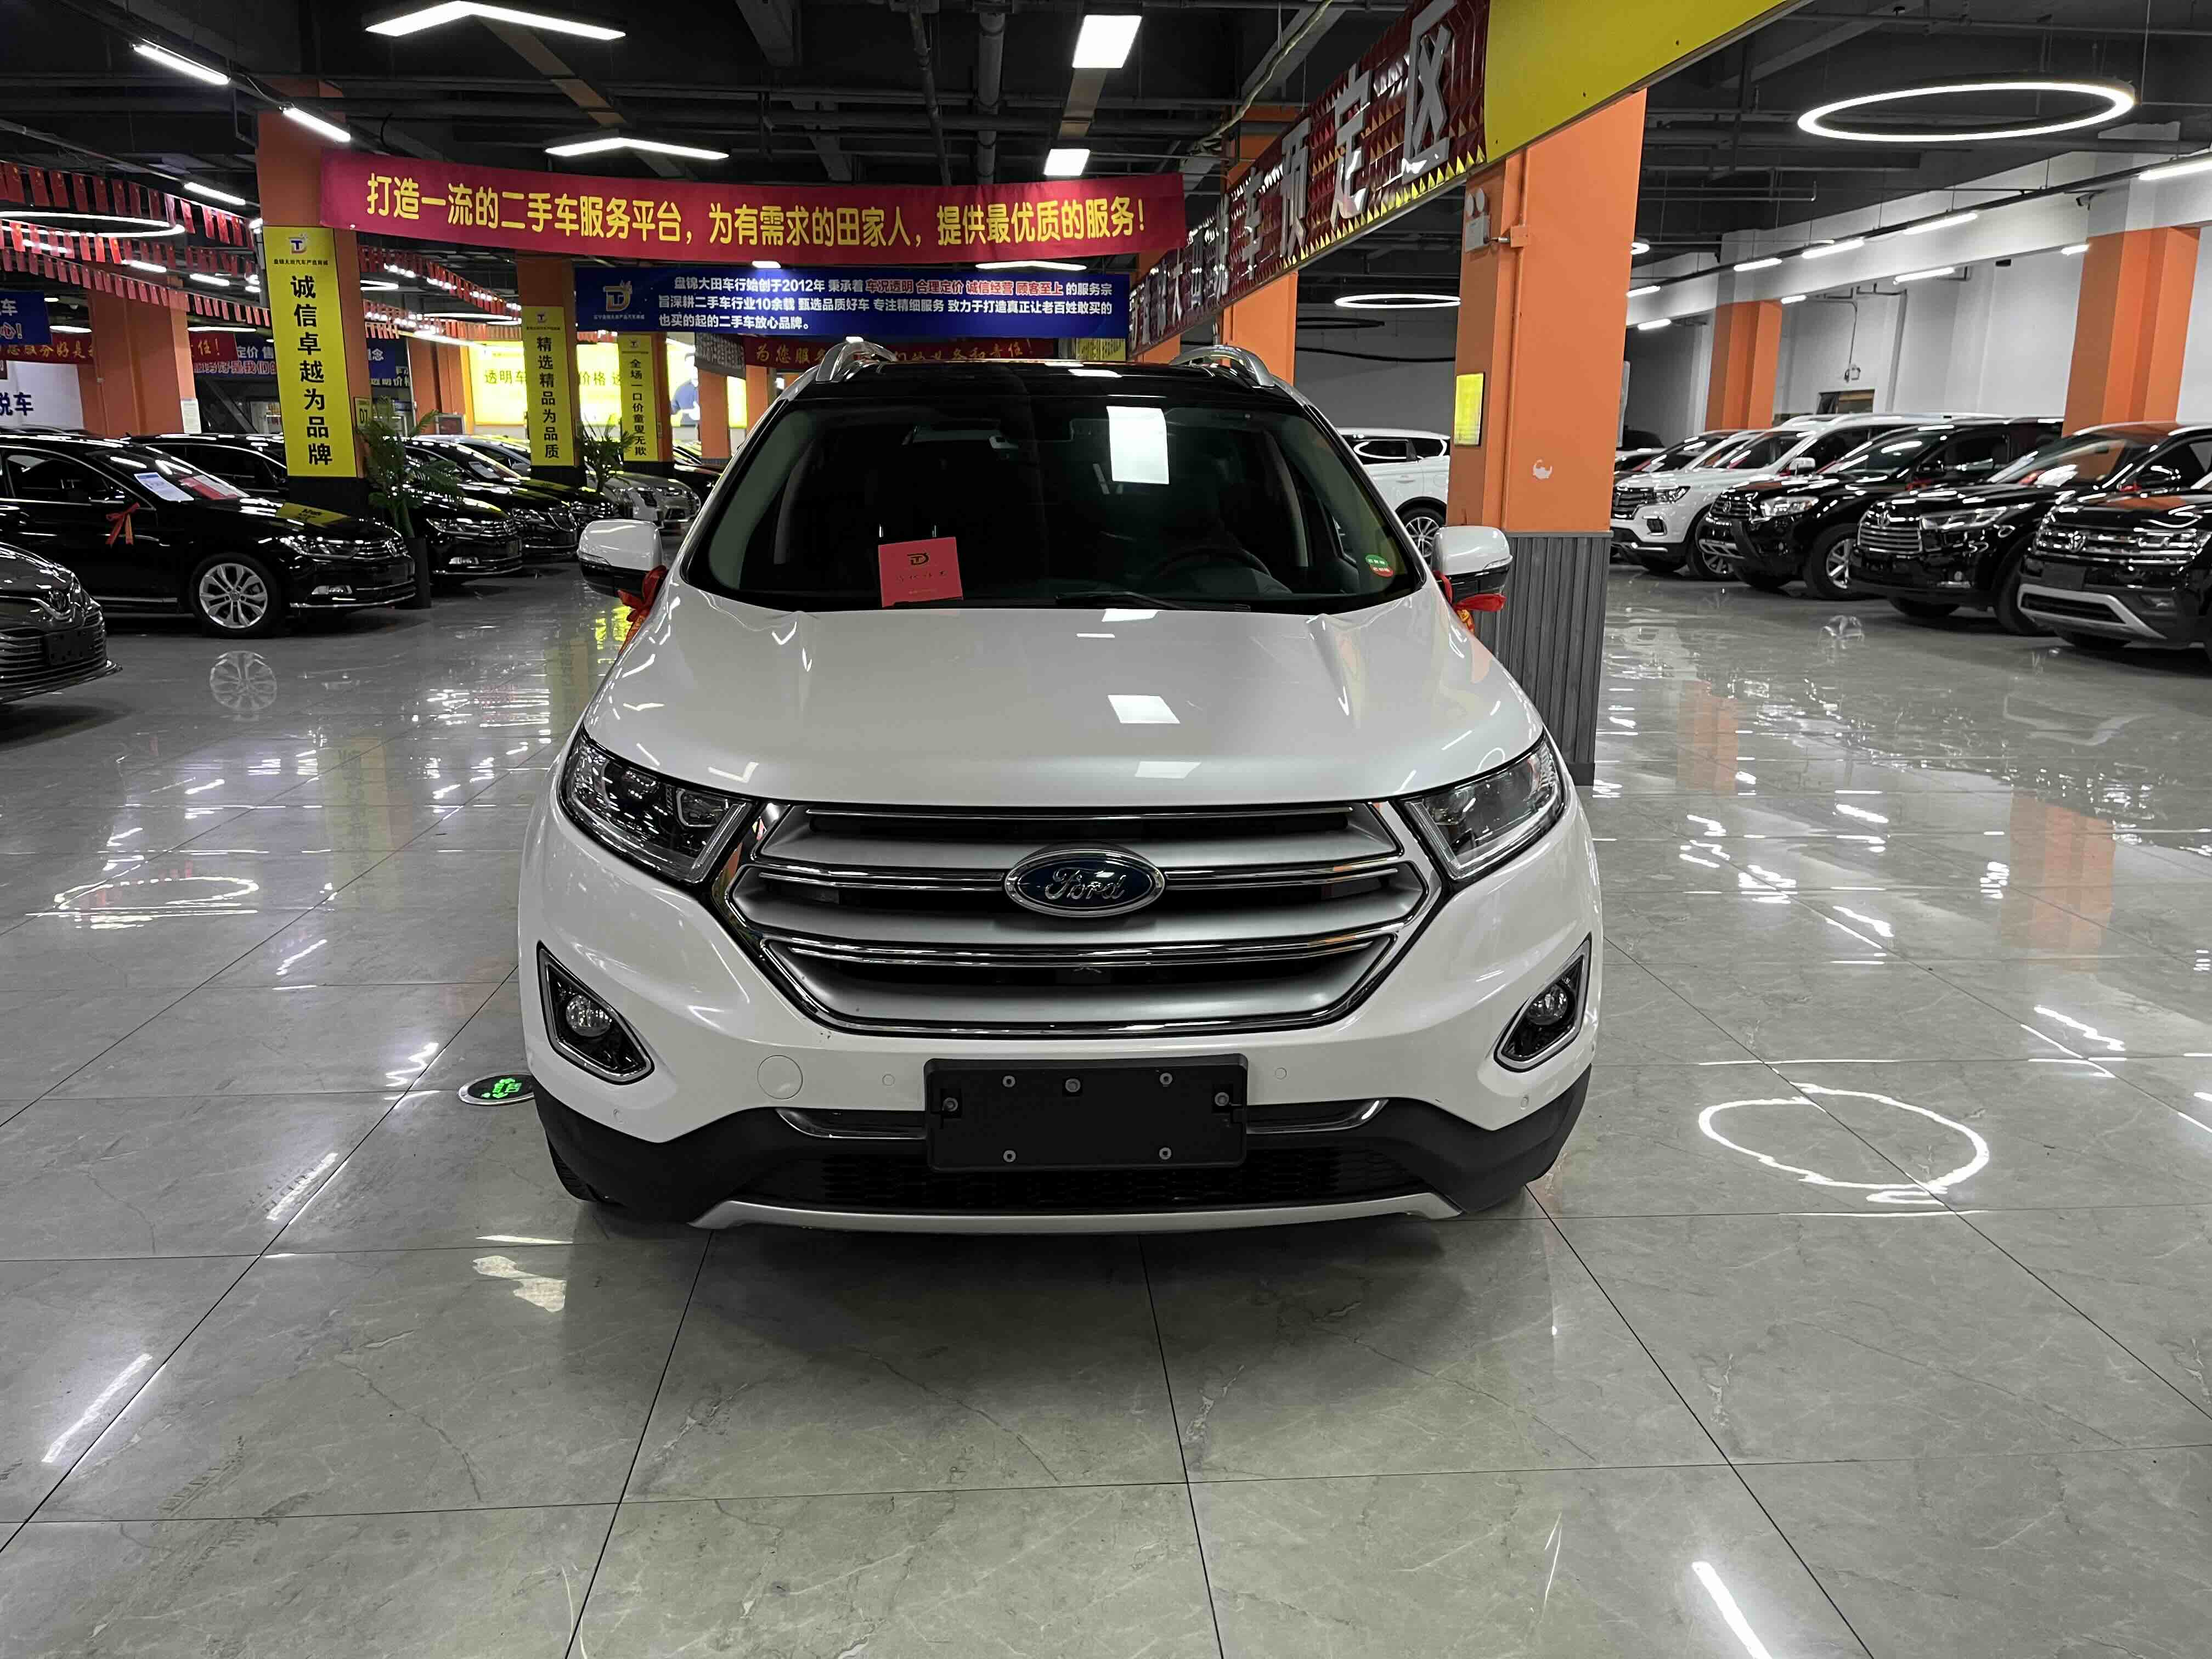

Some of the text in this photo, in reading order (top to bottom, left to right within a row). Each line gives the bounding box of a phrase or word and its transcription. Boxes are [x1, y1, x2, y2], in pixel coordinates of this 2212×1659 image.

[674, 276, 1112, 296] 盘锦大田车行始创于2012年 秉承着 车况透明 合理定价 诚信经营 顾客至上 的服务宗
[659, 295, 1111, 314] 旨深耕二手车行业10余载 甄选品质好车 专注精细服务 致力于打造真正让老百姓敢买的
[659, 314, 809, 330] 也买的起的二手车放心品牌。
[290, 275, 333, 465] 诚信卓越为品牌
[537, 336, 560, 458] 精选精品为品质
[630, 359, 647, 456] 全场一口价童叟无欺
[1045, 867, 1127, 900] Ford
